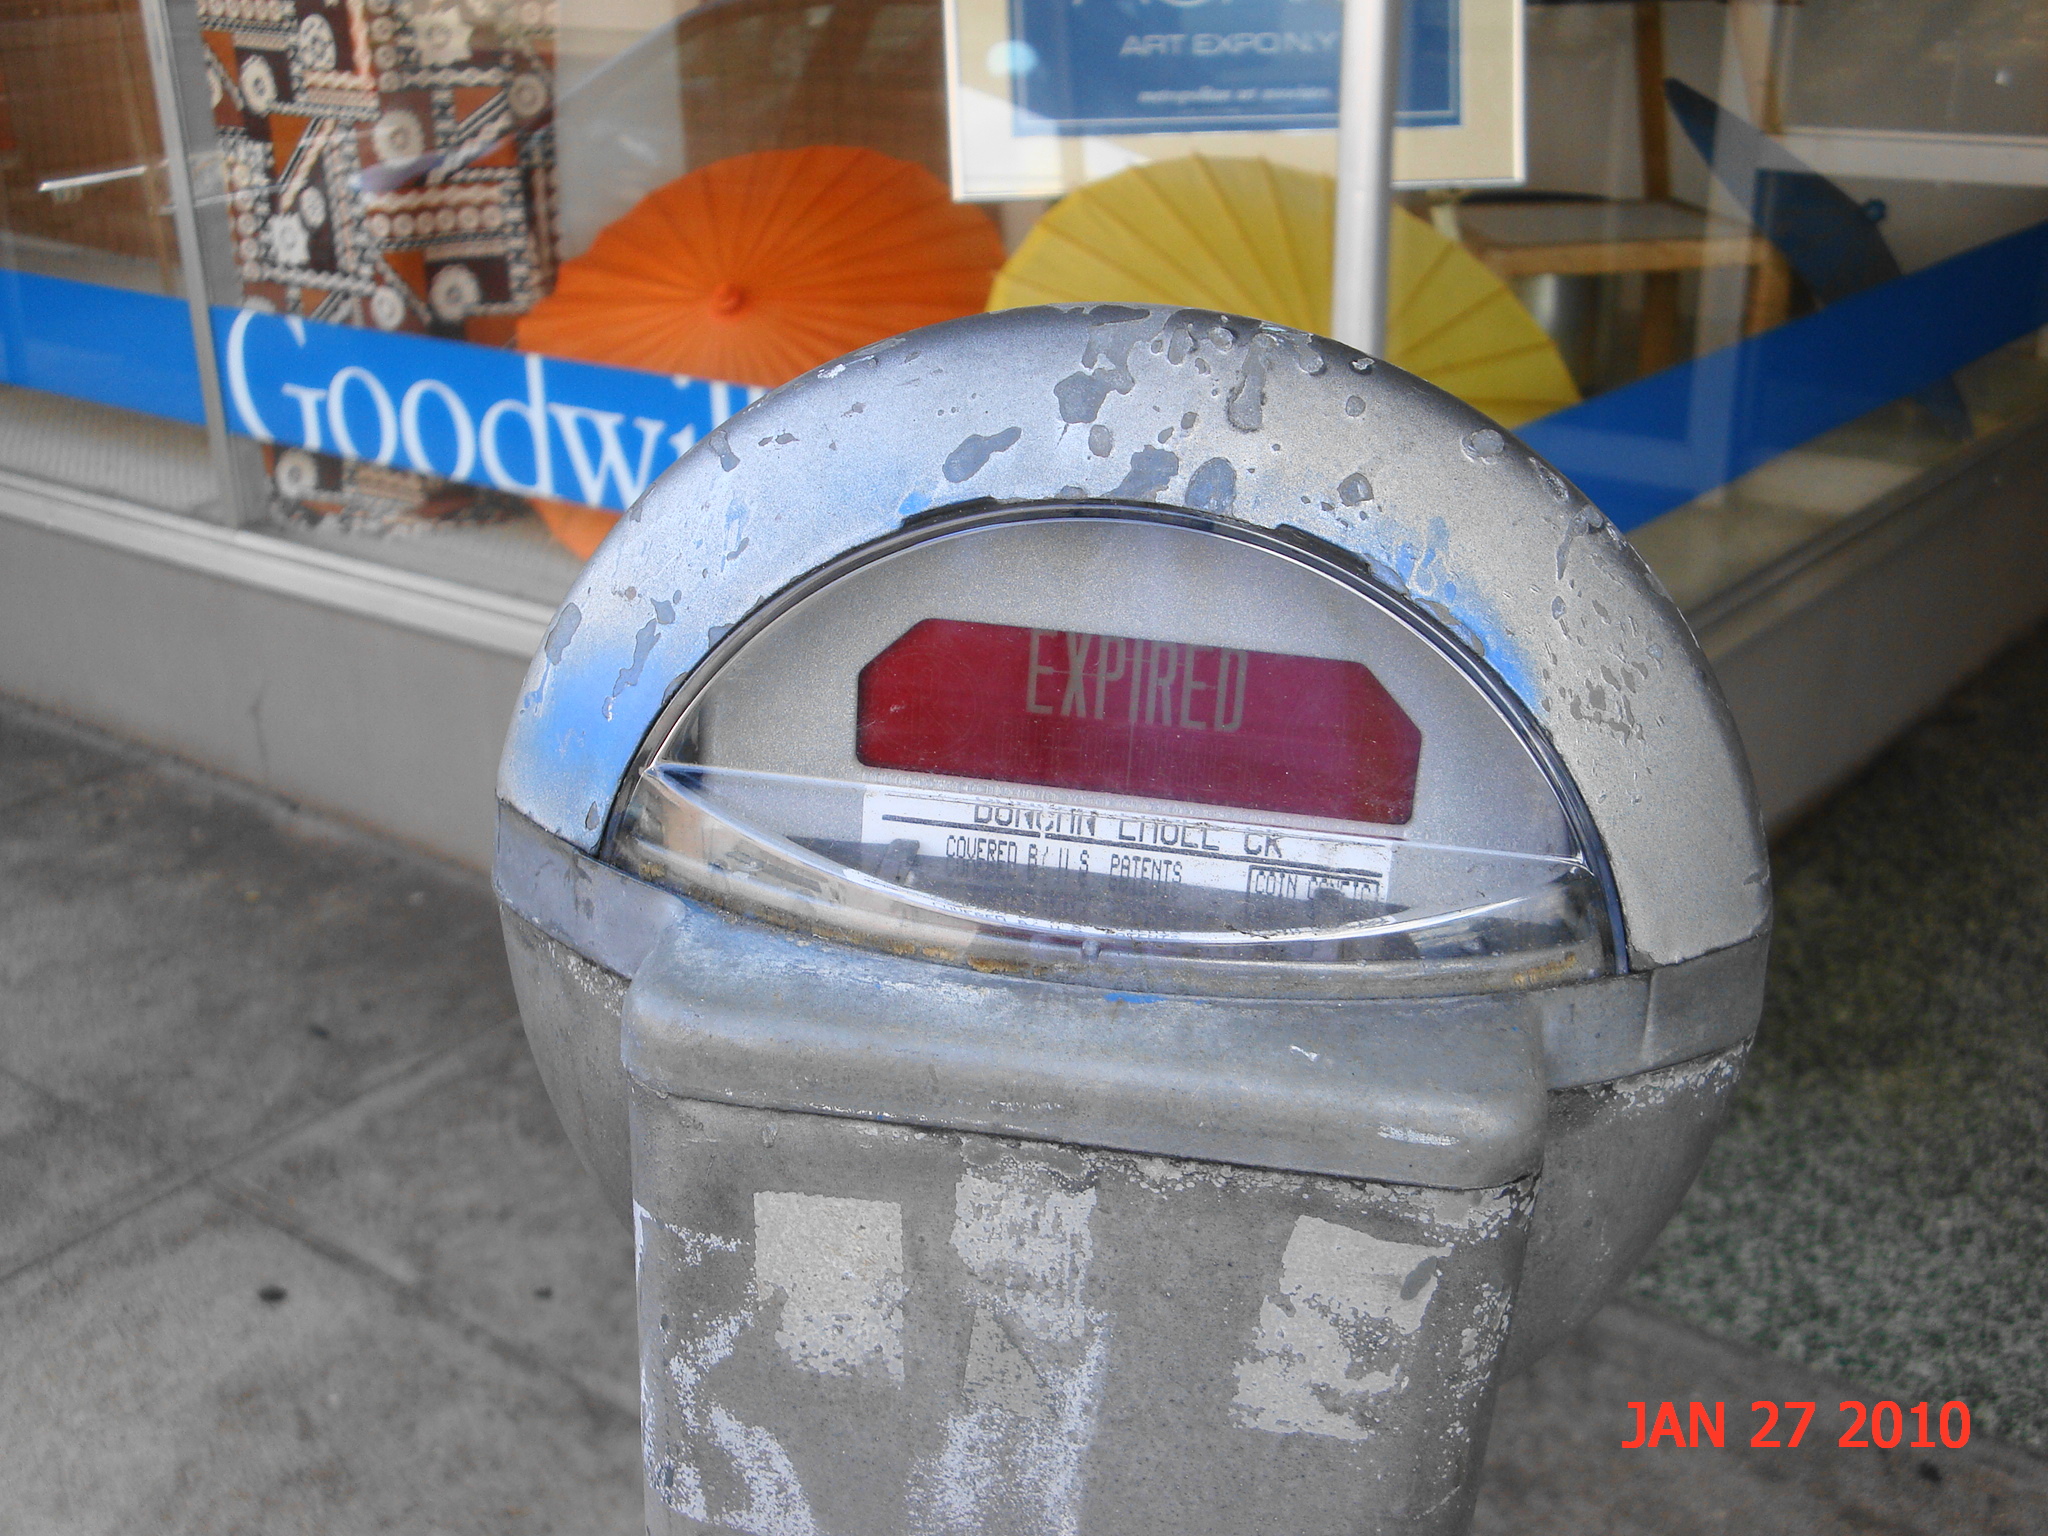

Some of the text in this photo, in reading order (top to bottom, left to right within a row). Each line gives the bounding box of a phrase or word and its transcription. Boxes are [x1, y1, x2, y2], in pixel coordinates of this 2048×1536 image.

[1119, 33, 1187, 57] ART
[1026, 628, 1249, 734] EXPIRED
[945, 834, 1018, 865] COVERED
[1109, 853, 1183, 884] PATENTS
[1256, 870, 1298, 900] COIN
